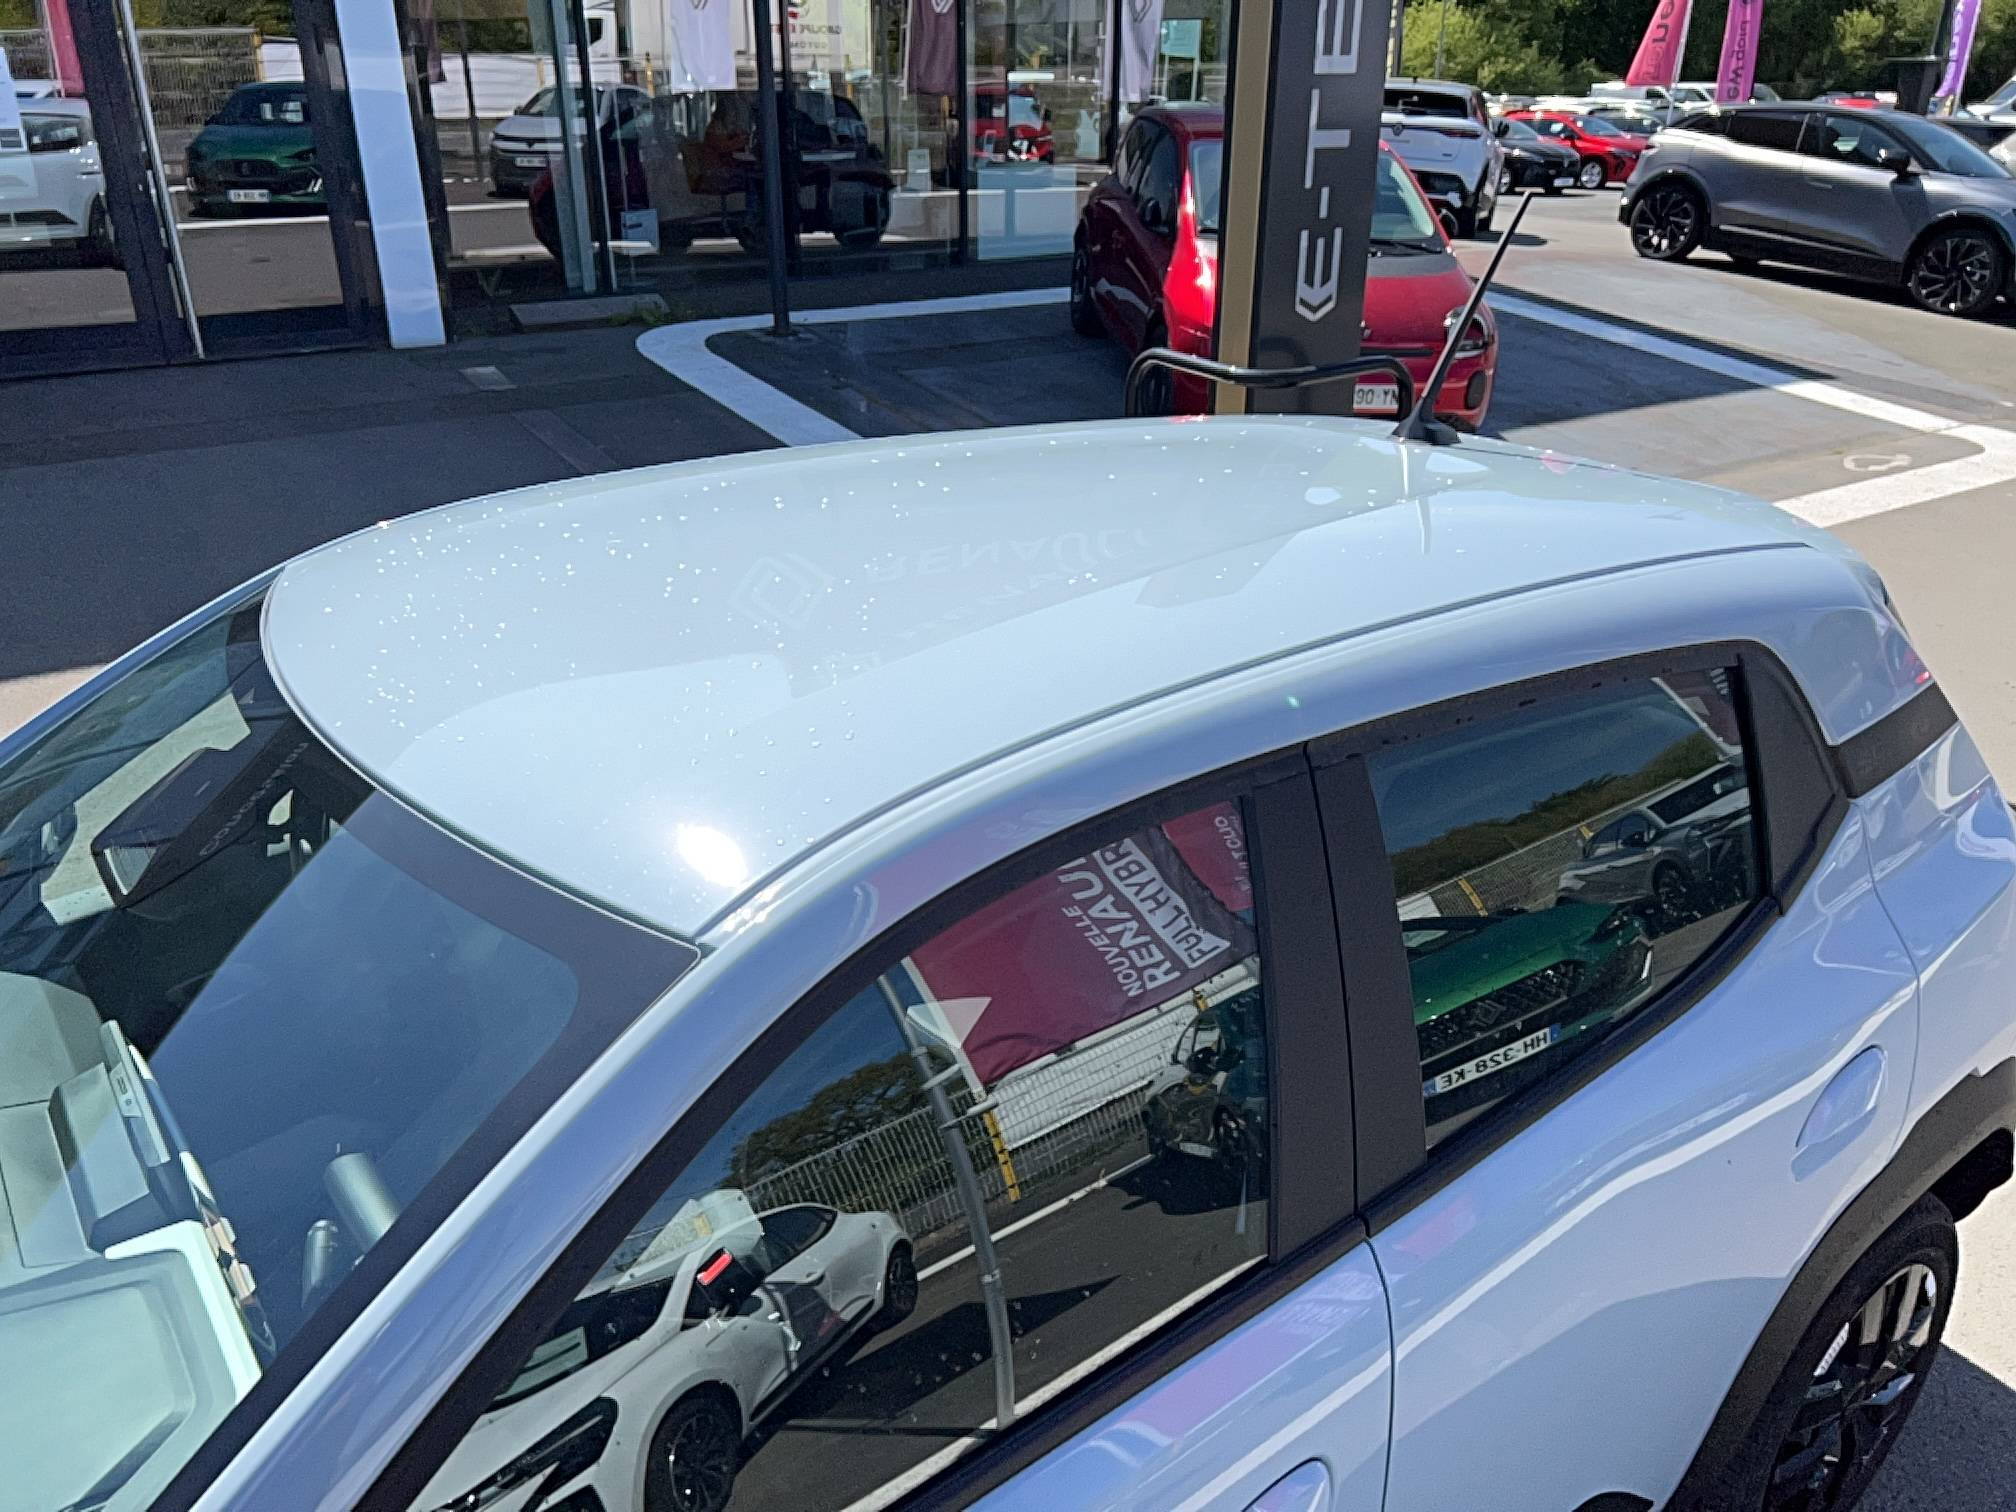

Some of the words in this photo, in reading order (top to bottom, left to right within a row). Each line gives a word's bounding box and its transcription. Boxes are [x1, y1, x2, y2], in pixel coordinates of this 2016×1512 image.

[1101, 842, 1172, 916] HYBR
[1062, 904, 1144, 997] NOUVELLE
[1163, 903, 1221, 965] FULL
